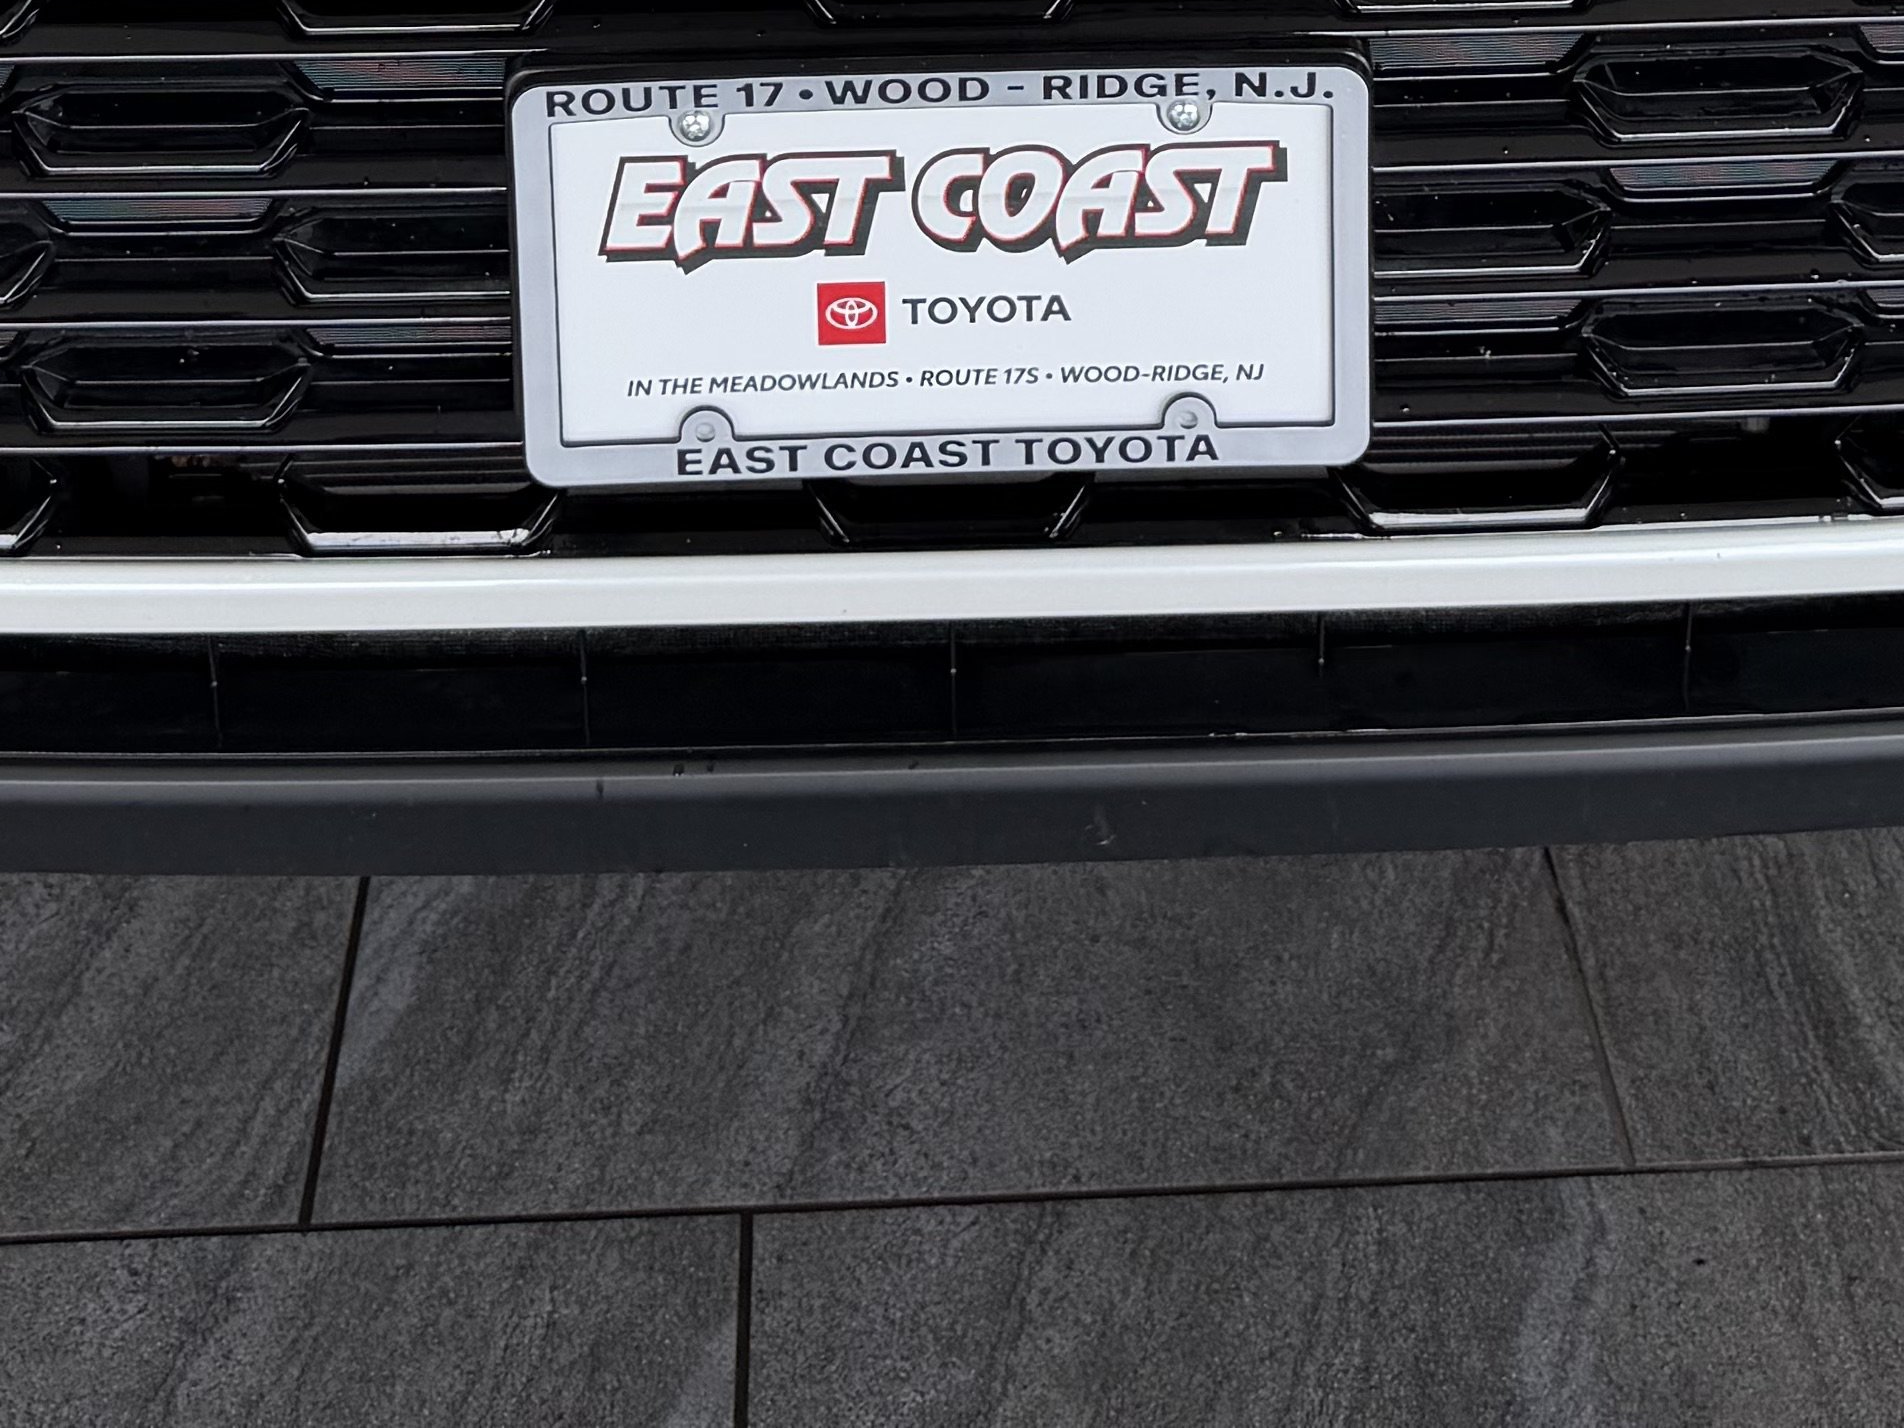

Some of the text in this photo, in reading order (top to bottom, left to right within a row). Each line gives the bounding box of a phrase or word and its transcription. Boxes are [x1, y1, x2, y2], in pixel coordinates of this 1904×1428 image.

[545, 82, 720, 120] ROUTE
[735, 82, 784, 108] 17
[824, 76, 990, 106] WOOD
[1042, 72, 1217, 102] RIDGE,
[1234, 71, 1335, 99] N.J.
[598, 140, 1288, 275] EAST COAST
[901, 294, 1073, 326] TOYOTA
[627, 363, 1265, 397] IN THE MEADOWLANDS ROUTE 17S WOOD-RIDGE, NJ
[676, 434, 1220, 476] EAST COAST TOYOTA
